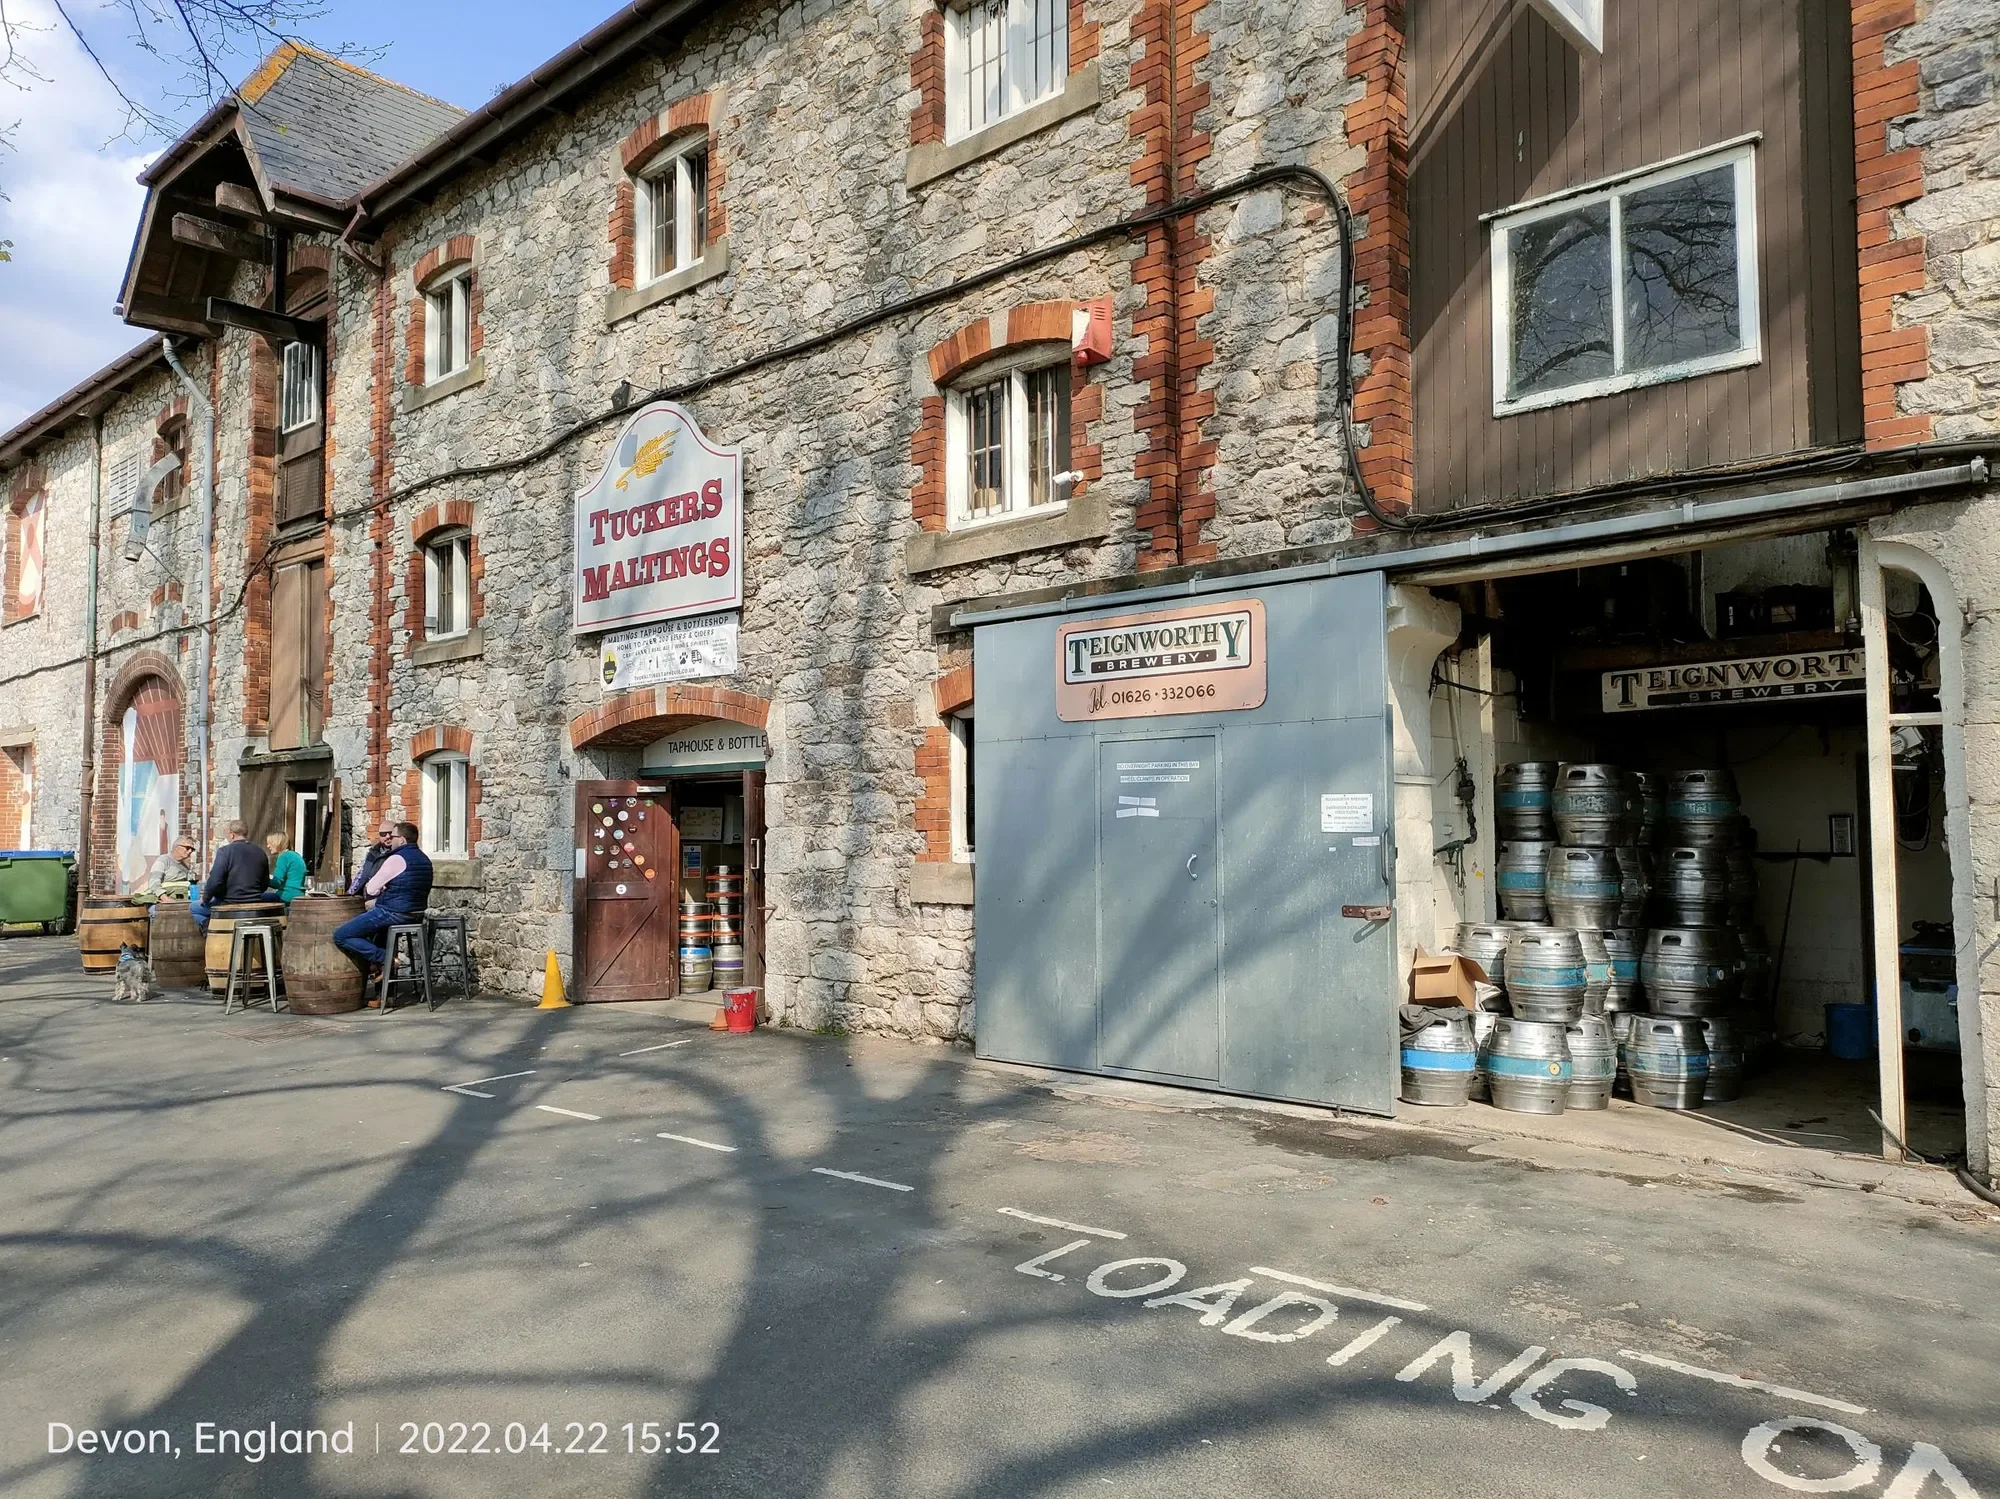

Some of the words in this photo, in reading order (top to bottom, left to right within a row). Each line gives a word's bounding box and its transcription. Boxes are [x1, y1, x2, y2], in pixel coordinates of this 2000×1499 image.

[589, 478, 723, 546] TUCKERS
[581, 537, 731, 604] MALTINGS
[607, 631, 637, 644] MALTINGS
[640, 622, 675, 638] TAPHOUSE
[677, 620, 682, 631] &
[683, 616, 729, 629] BOTTLESHOP
[616, 641, 632, 651] HOME
[634, 640, 641, 648] TO
[694, 628, 714, 638] CIDERS
[1068, 620, 1247, 675] TEIGNWORTHY
[1106, 651, 1200, 671] BREWERY
[1611, 652, 1866, 707] TEIGNWORT
[1689, 681, 1843, 702] BREWERY
[668, 738, 714, 754] TAPHOUSE
[717, 738, 725, 751] &
[1161, 774, 1189, 782] OPERATION
[1013, 1239, 1639, 1431] LOADING
